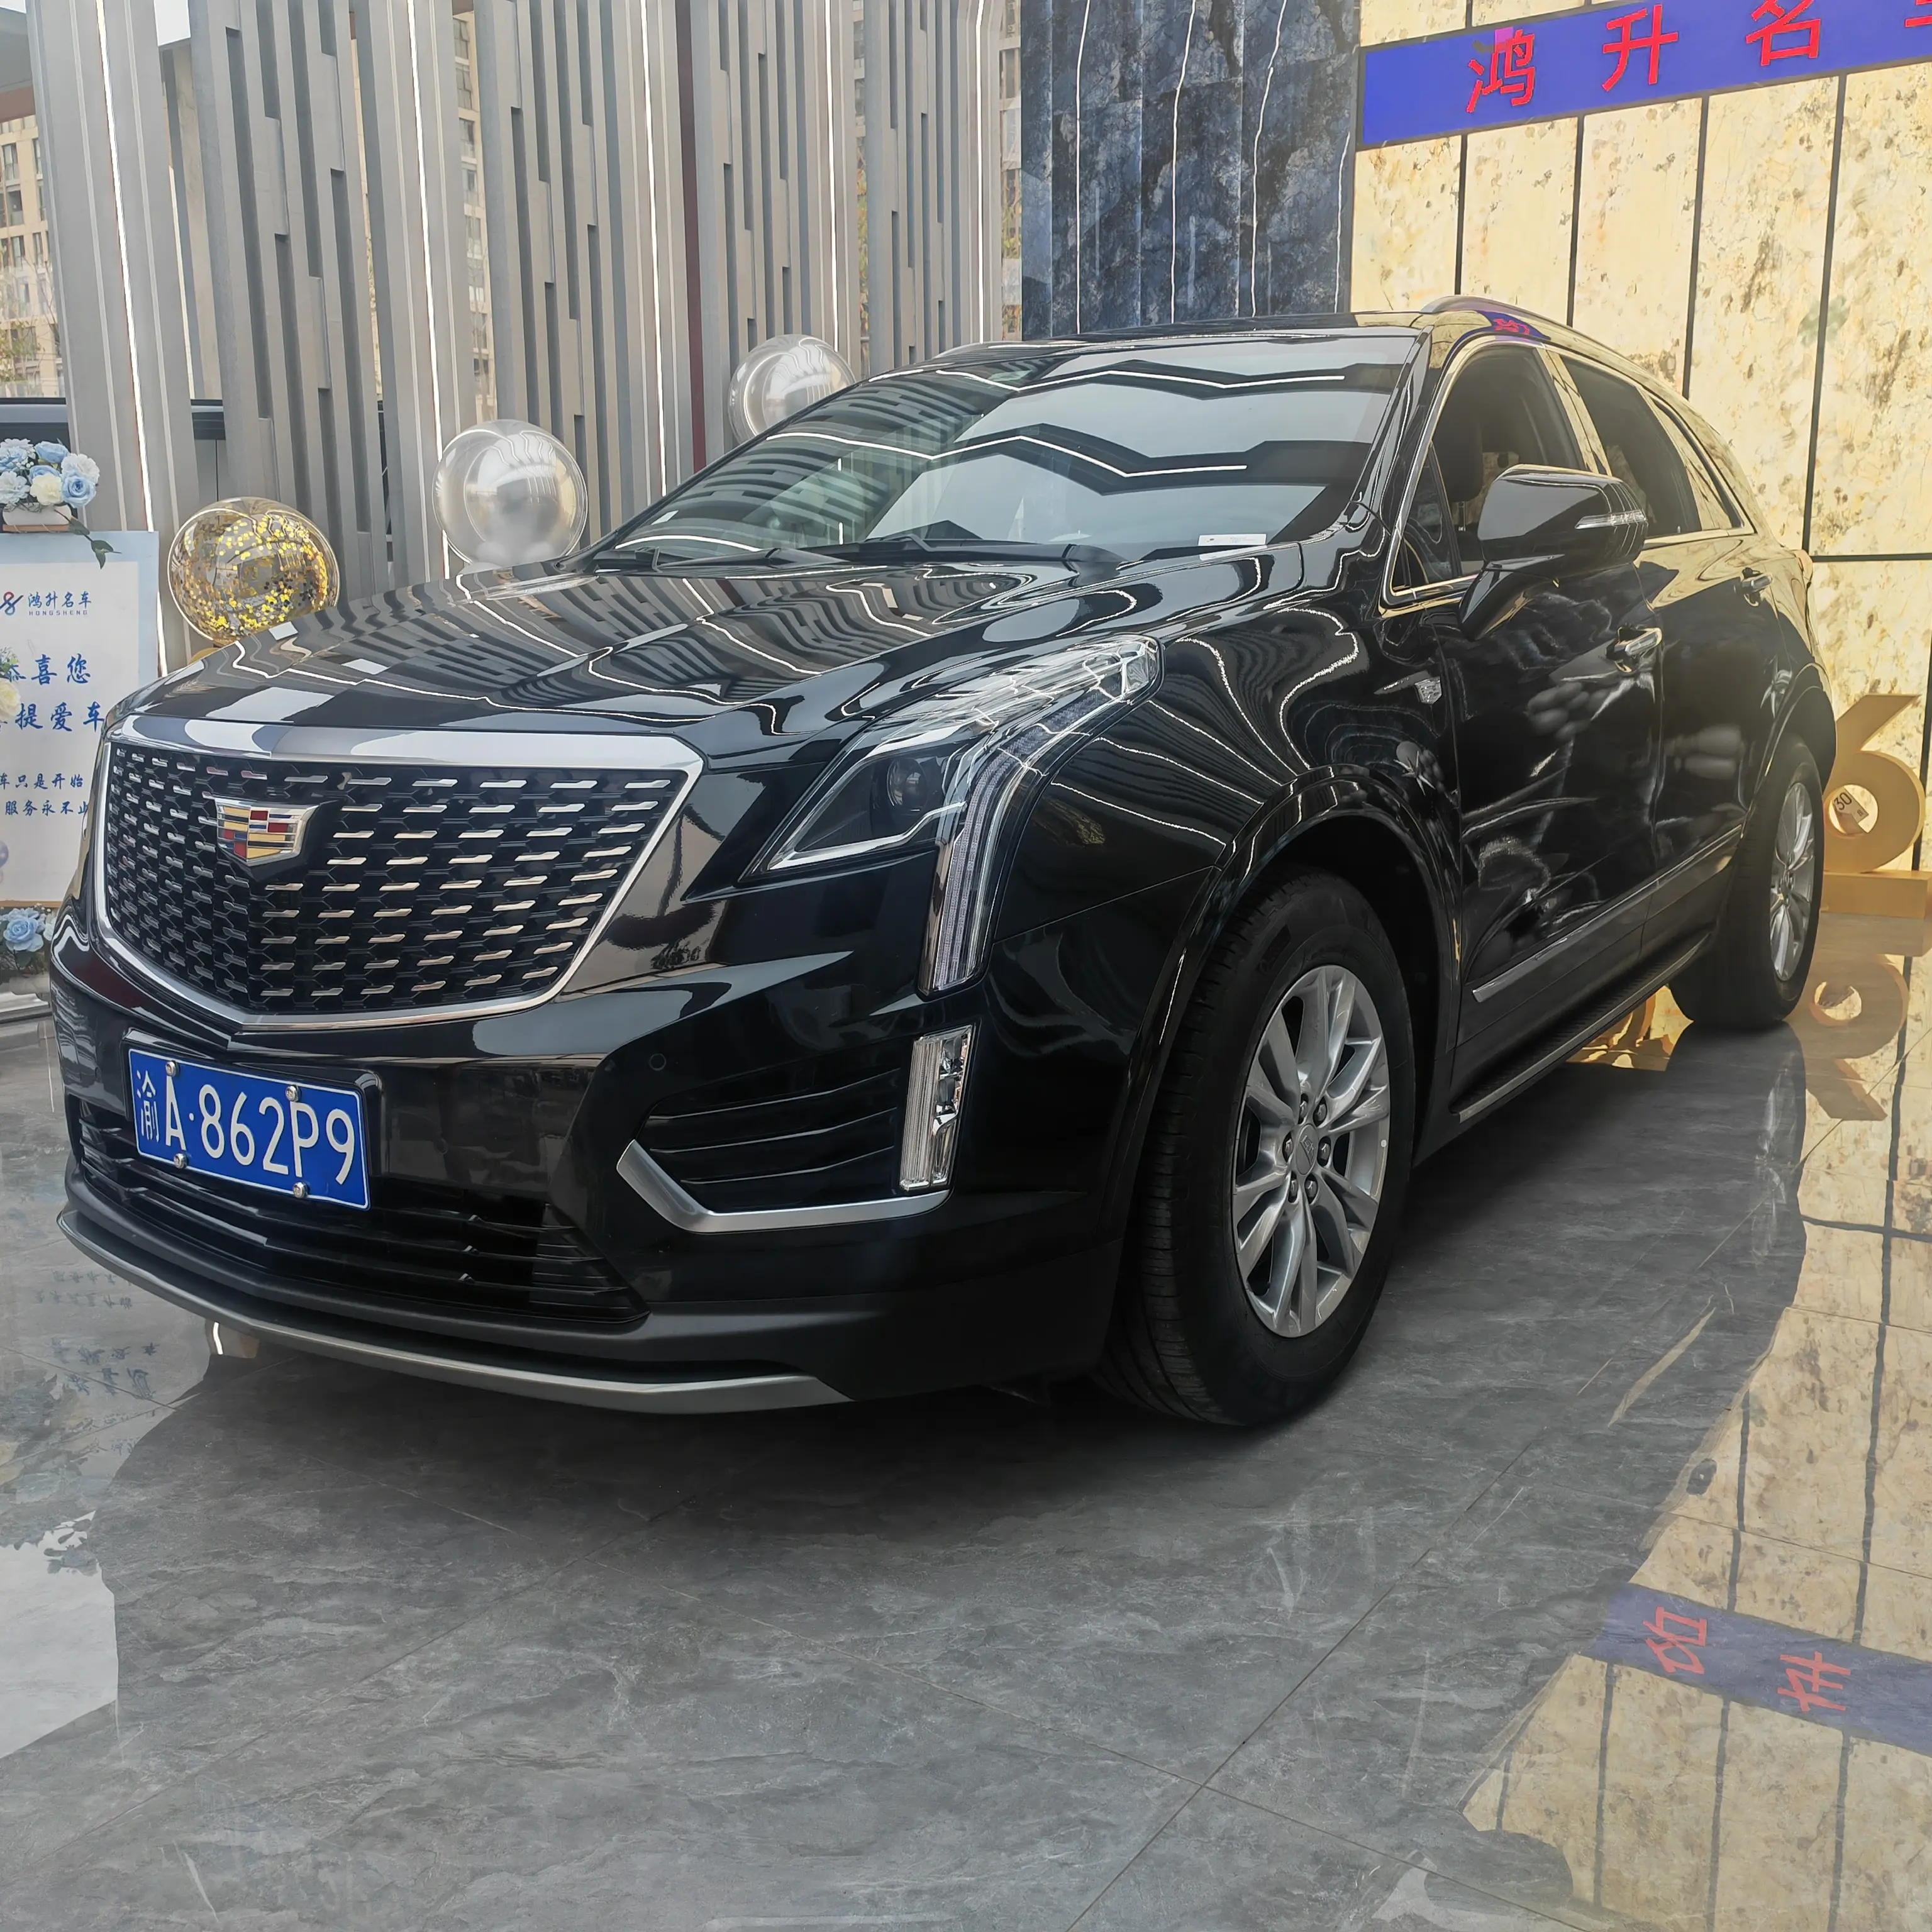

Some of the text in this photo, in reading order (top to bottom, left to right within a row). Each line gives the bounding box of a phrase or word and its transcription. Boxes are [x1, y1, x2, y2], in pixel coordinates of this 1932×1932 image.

[1465, 0, 1932, 114] 鸿升名
[28, 591, 92, 609] 鸿升名车
[0, 701, 105, 733] 提爱车
[136, 1069, 355, 1185] 渝A·862P9
